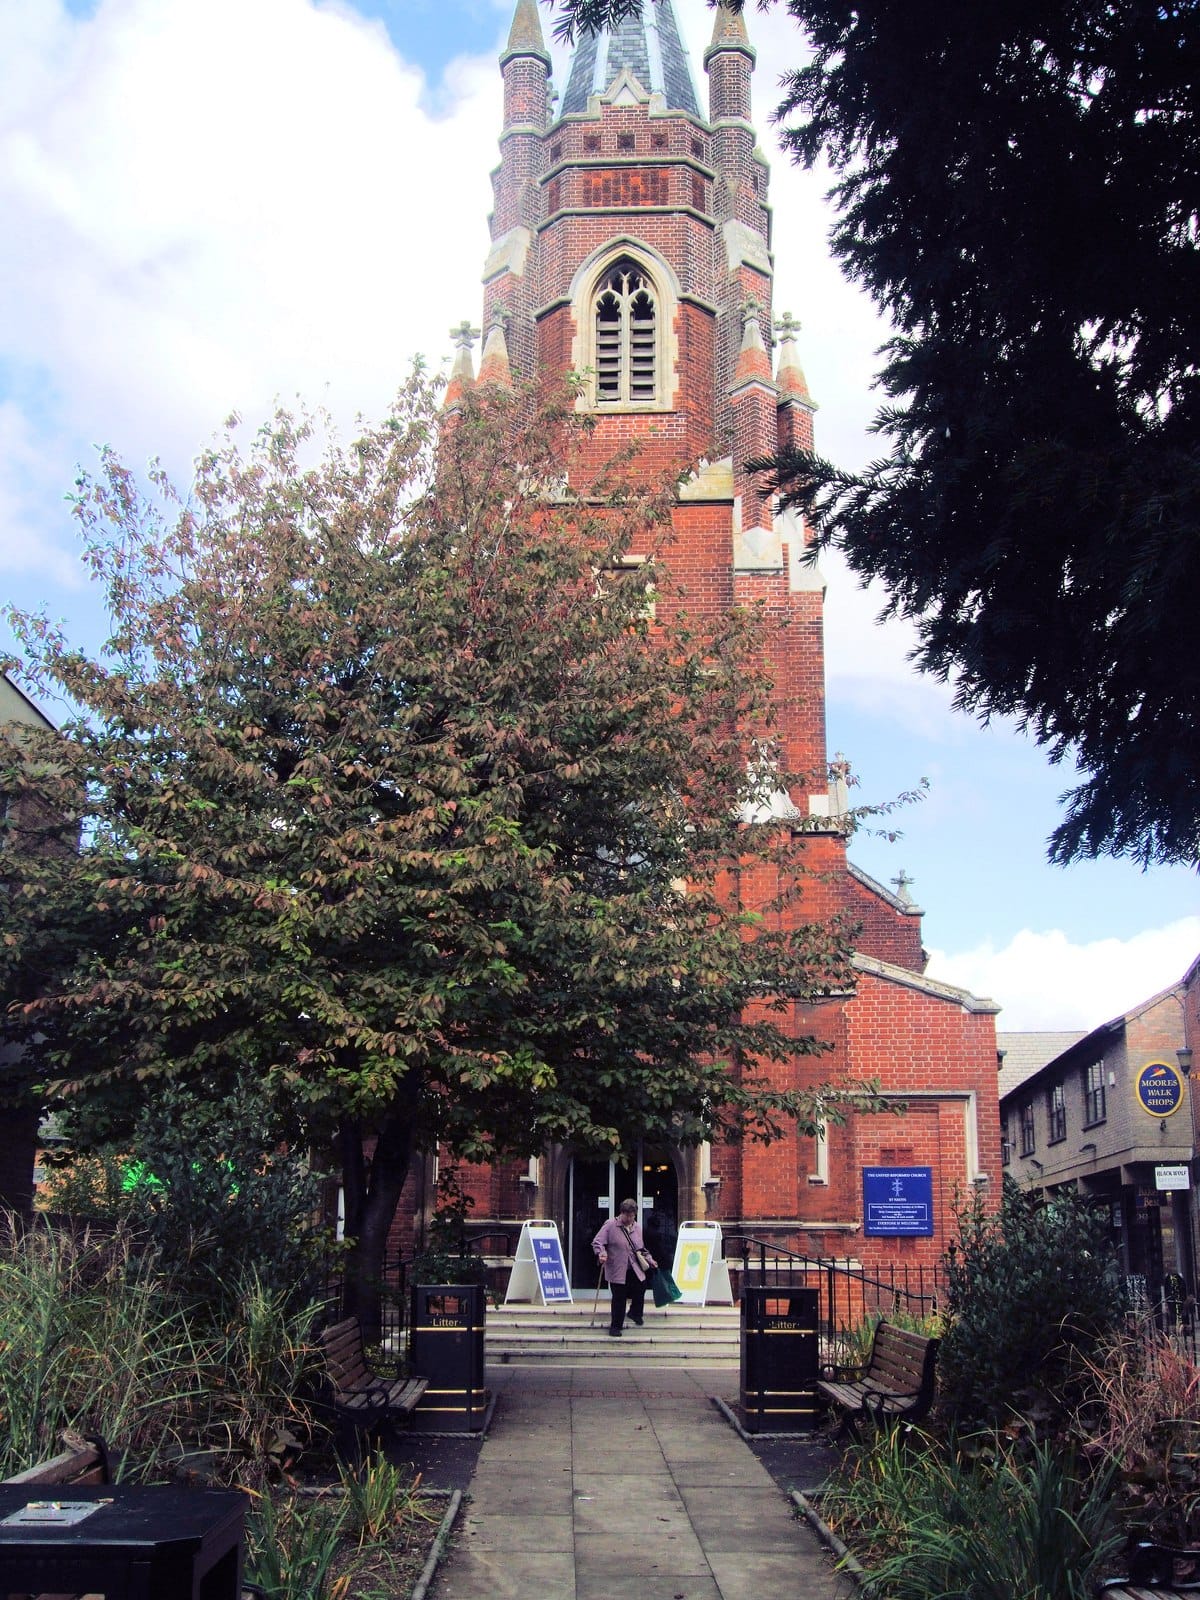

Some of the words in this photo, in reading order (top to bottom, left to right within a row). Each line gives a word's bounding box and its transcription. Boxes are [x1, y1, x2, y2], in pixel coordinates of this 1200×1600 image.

[1142, 1079, 1178, 1087] MOORES
[1147, 1098, 1174, 1106] SHOPS
[432, 1318, 458, 1326] Litter
[771, 1321, 797, 1329] Litter
